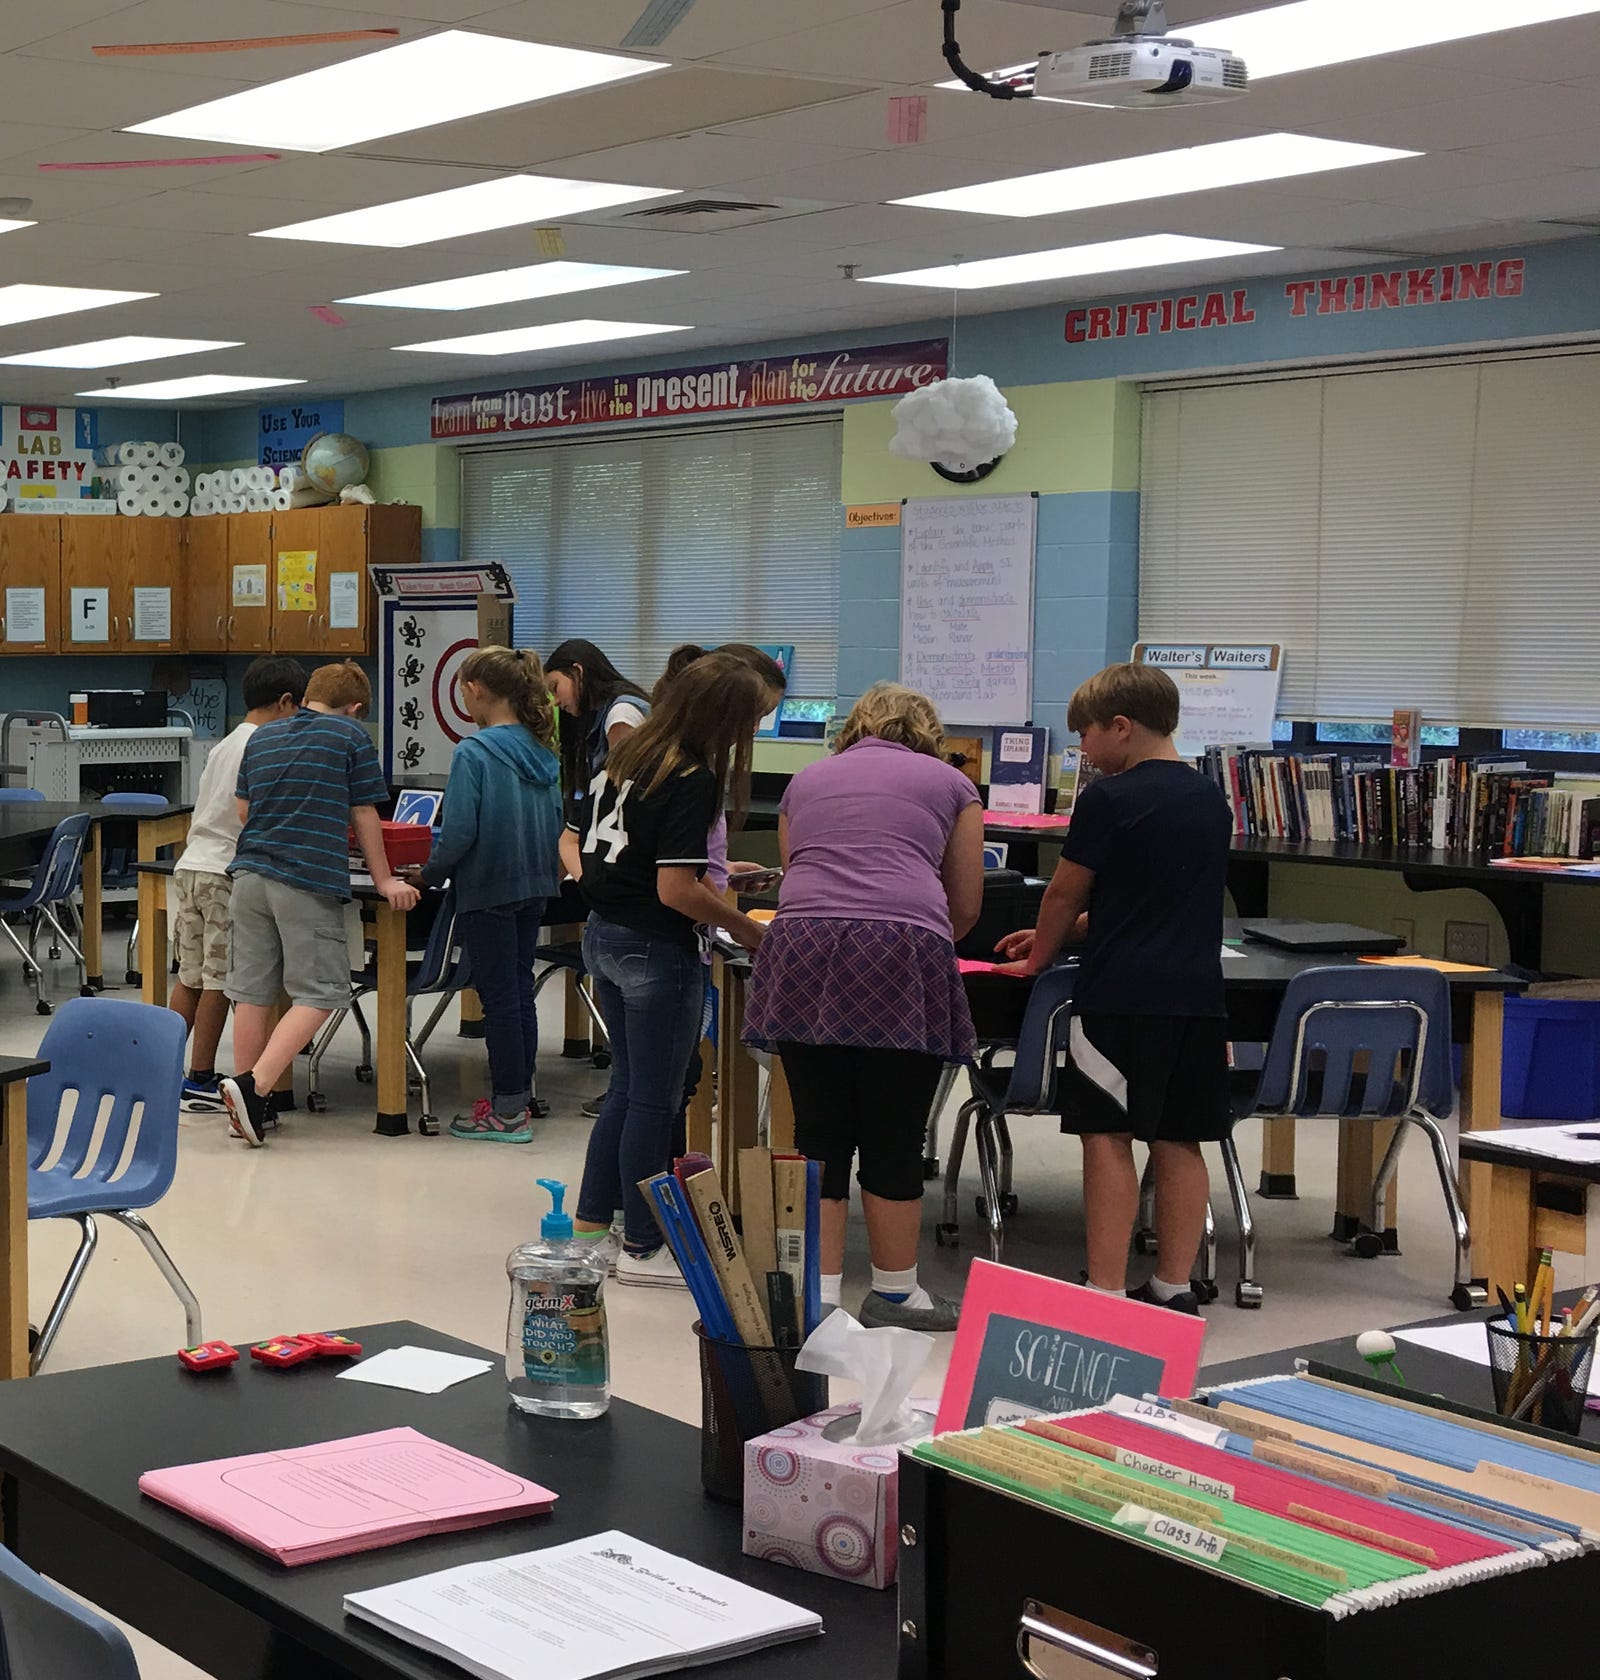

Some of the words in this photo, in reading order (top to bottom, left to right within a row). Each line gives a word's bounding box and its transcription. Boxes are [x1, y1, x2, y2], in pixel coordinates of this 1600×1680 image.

[1064, 288, 1256, 343] CRITICAL
[1285, 258, 1525, 318] THINKING
[791, 358, 817, 378] for
[805, 352, 941, 401] future.
[614, 378, 629, 397] in
[636, 364, 747, 417] present,
[750, 360, 787, 407] plan
[789, 378, 818, 400] the
[471, 395, 501, 414] from
[503, 388, 576, 430] past,
[580, 381, 607, 418] live
[609, 397, 633, 417] the
[434, 398, 470, 435] Learn
[476, 413, 497, 430] the
[18, 434, 61, 456] LAB
[263, 446, 304, 464] SCIENC
[1, 459, 86, 481] AFETY
[848, 512, 896, 525] Objectives:
[83, 598, 97, 620] F
[1148, 650, 1202, 662] Walter's
[1214, 650, 1266, 663] Waiters
[189, 687, 220, 709] the
[1004, 737, 1030, 746] THING
[582, 770, 635, 864] 14
[708, 1200, 737, 1263] WSREO
[531, 1318, 566, 1330] WHAT
[525, 1338, 575, 1352] TOUCH?
[550, 1331, 572, 1341] YOU
[1134, 1401, 1178, 1422] LABS
[1122, 1452, 1184, 1481] Chapter
[1188, 1473, 1231, 1500] H-outs
[1154, 1519, 1191, 1546] Class
[1194, 1531, 1220, 1557] Info.
